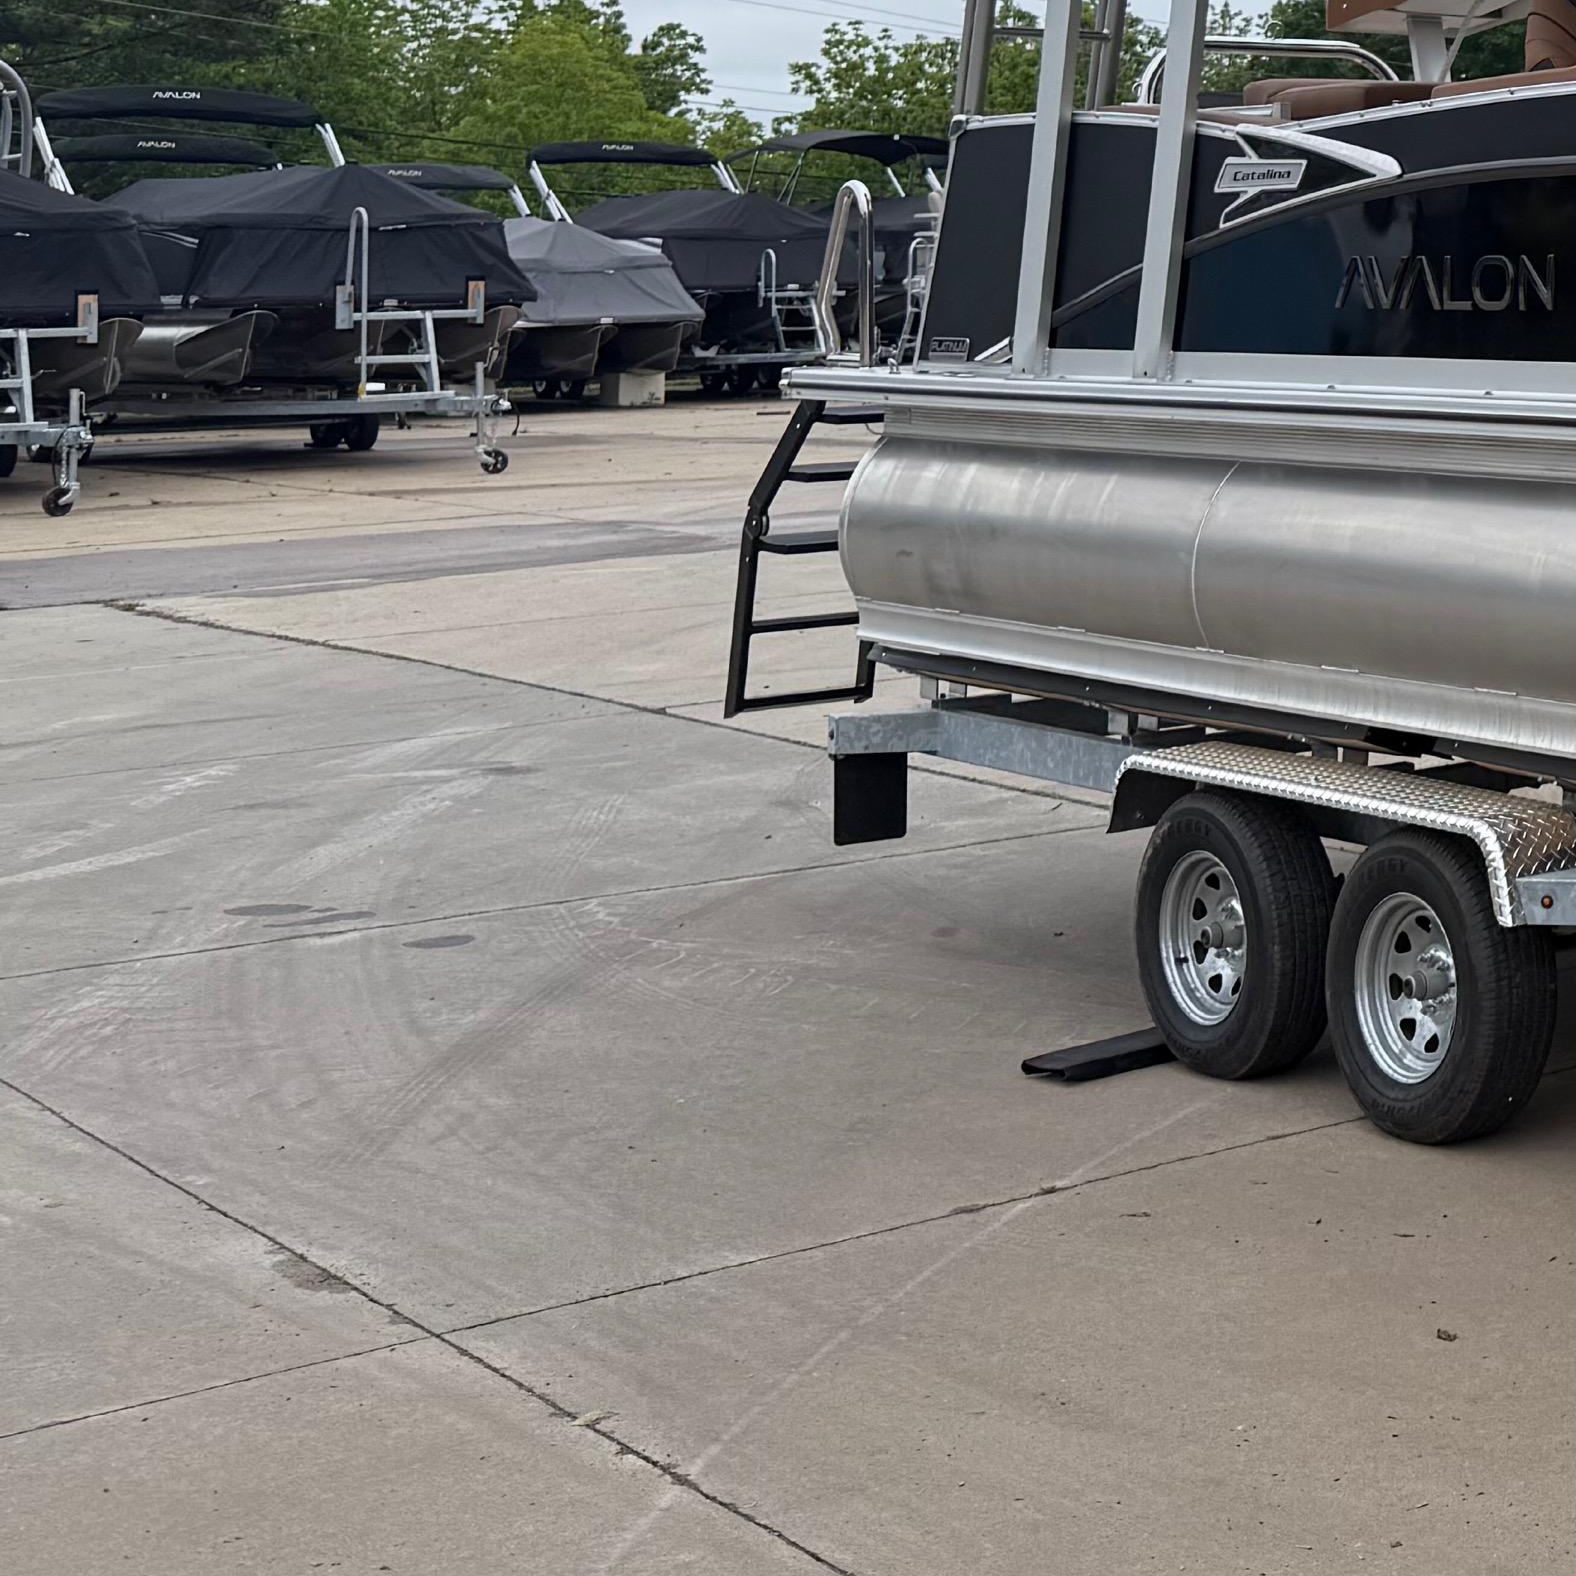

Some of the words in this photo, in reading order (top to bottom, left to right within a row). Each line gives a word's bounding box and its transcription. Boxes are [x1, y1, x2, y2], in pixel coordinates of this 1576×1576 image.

[152, 91, 201, 100] AVALON
[1233, 168, 1292, 182] Catalina
[1334, 254, 1556, 311] AVALON
